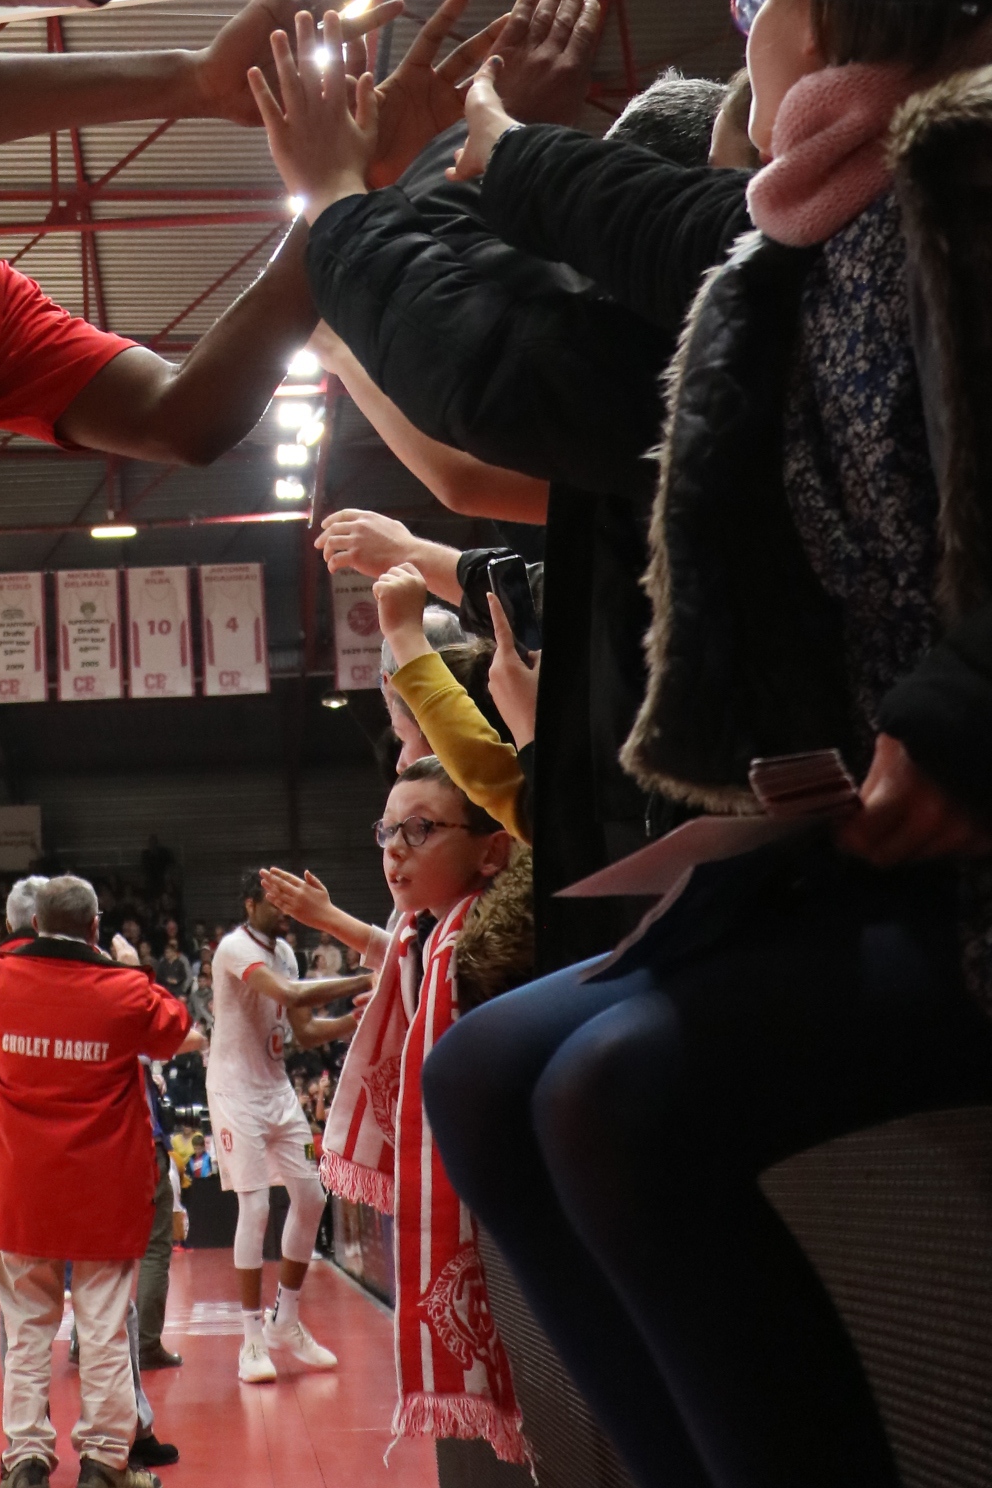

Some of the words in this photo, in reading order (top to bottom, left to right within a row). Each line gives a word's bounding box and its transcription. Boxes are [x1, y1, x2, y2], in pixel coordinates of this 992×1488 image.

[147, 619, 172, 635] 10
[225, 616, 239, 632] 4
[1, 1032, 51, 1058] CHOLET
[53, 1039, 110, 1062] BASKET
